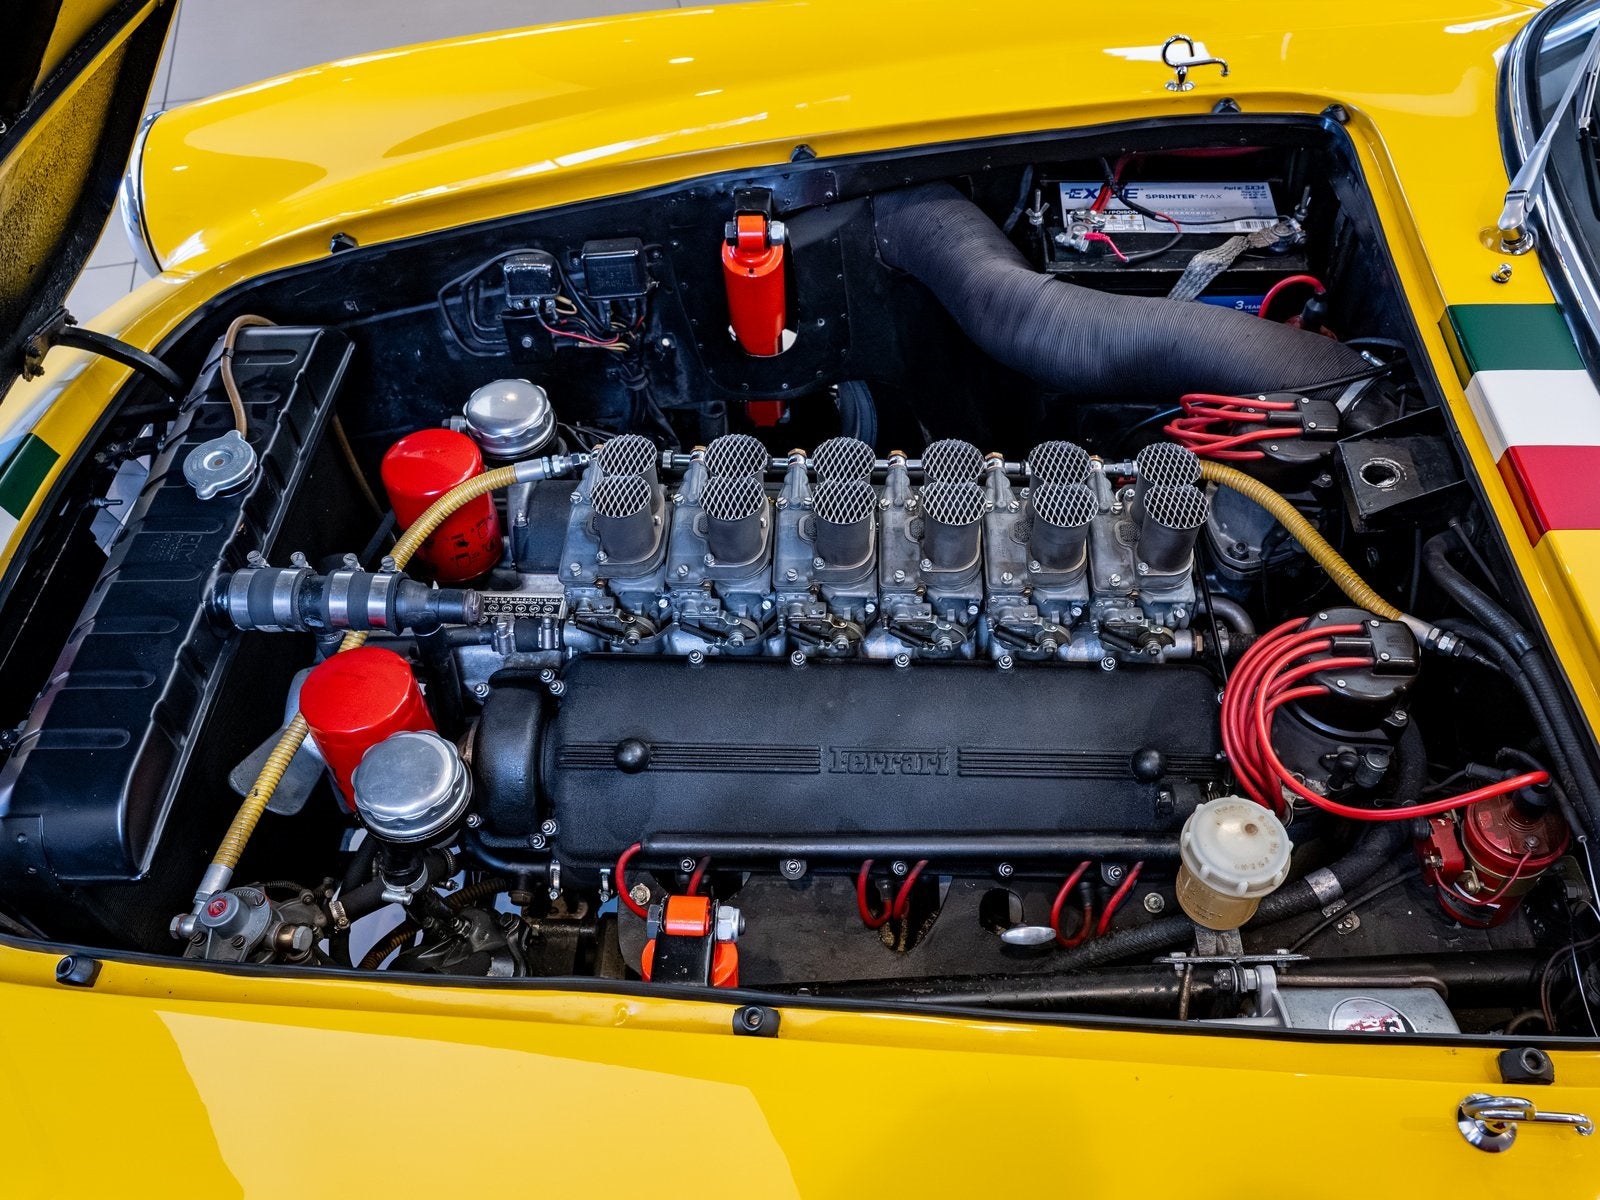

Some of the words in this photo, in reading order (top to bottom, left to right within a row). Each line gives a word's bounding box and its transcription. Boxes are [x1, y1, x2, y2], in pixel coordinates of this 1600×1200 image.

[1065, 188, 1139, 199] EXE
[1235, 300, 1244, 310] 3
[829, 746, 949, 776] Ferrari
